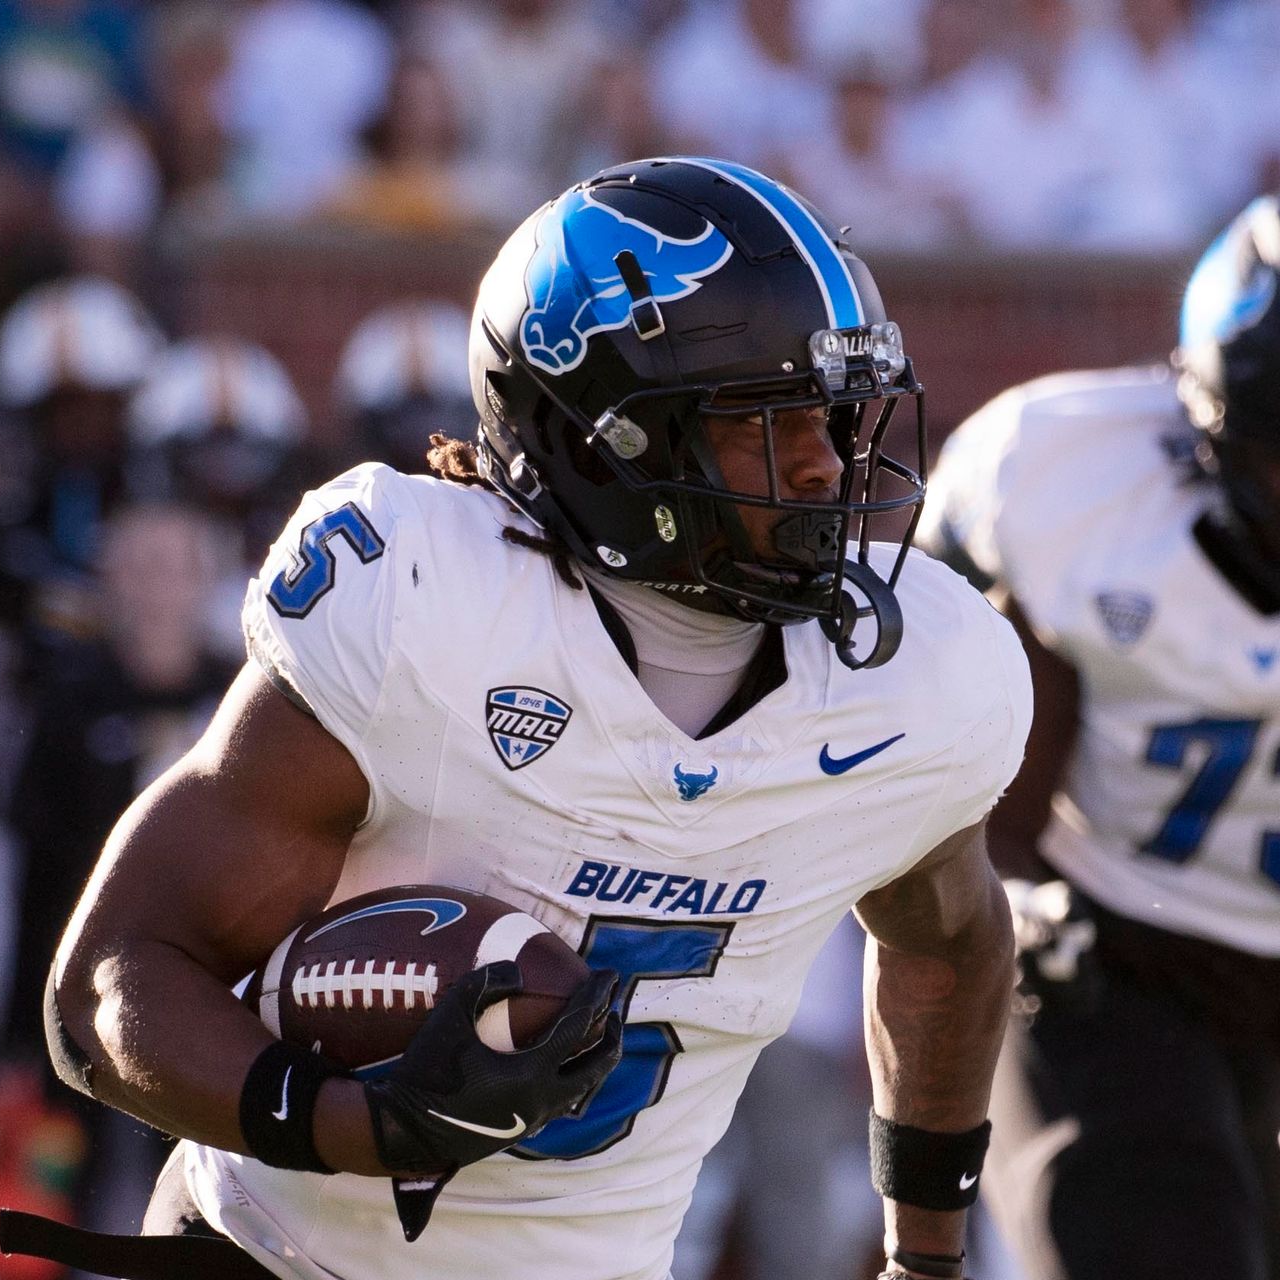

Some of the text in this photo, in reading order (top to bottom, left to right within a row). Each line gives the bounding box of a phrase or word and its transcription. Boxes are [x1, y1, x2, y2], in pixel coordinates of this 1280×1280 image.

[266, 501, 385, 619] 5
[487, 708, 564, 742] MAC
[519, 696, 542, 709] 1946
[564, 860, 767, 915] BUFFALO
[503, 913, 737, 1161] 5
